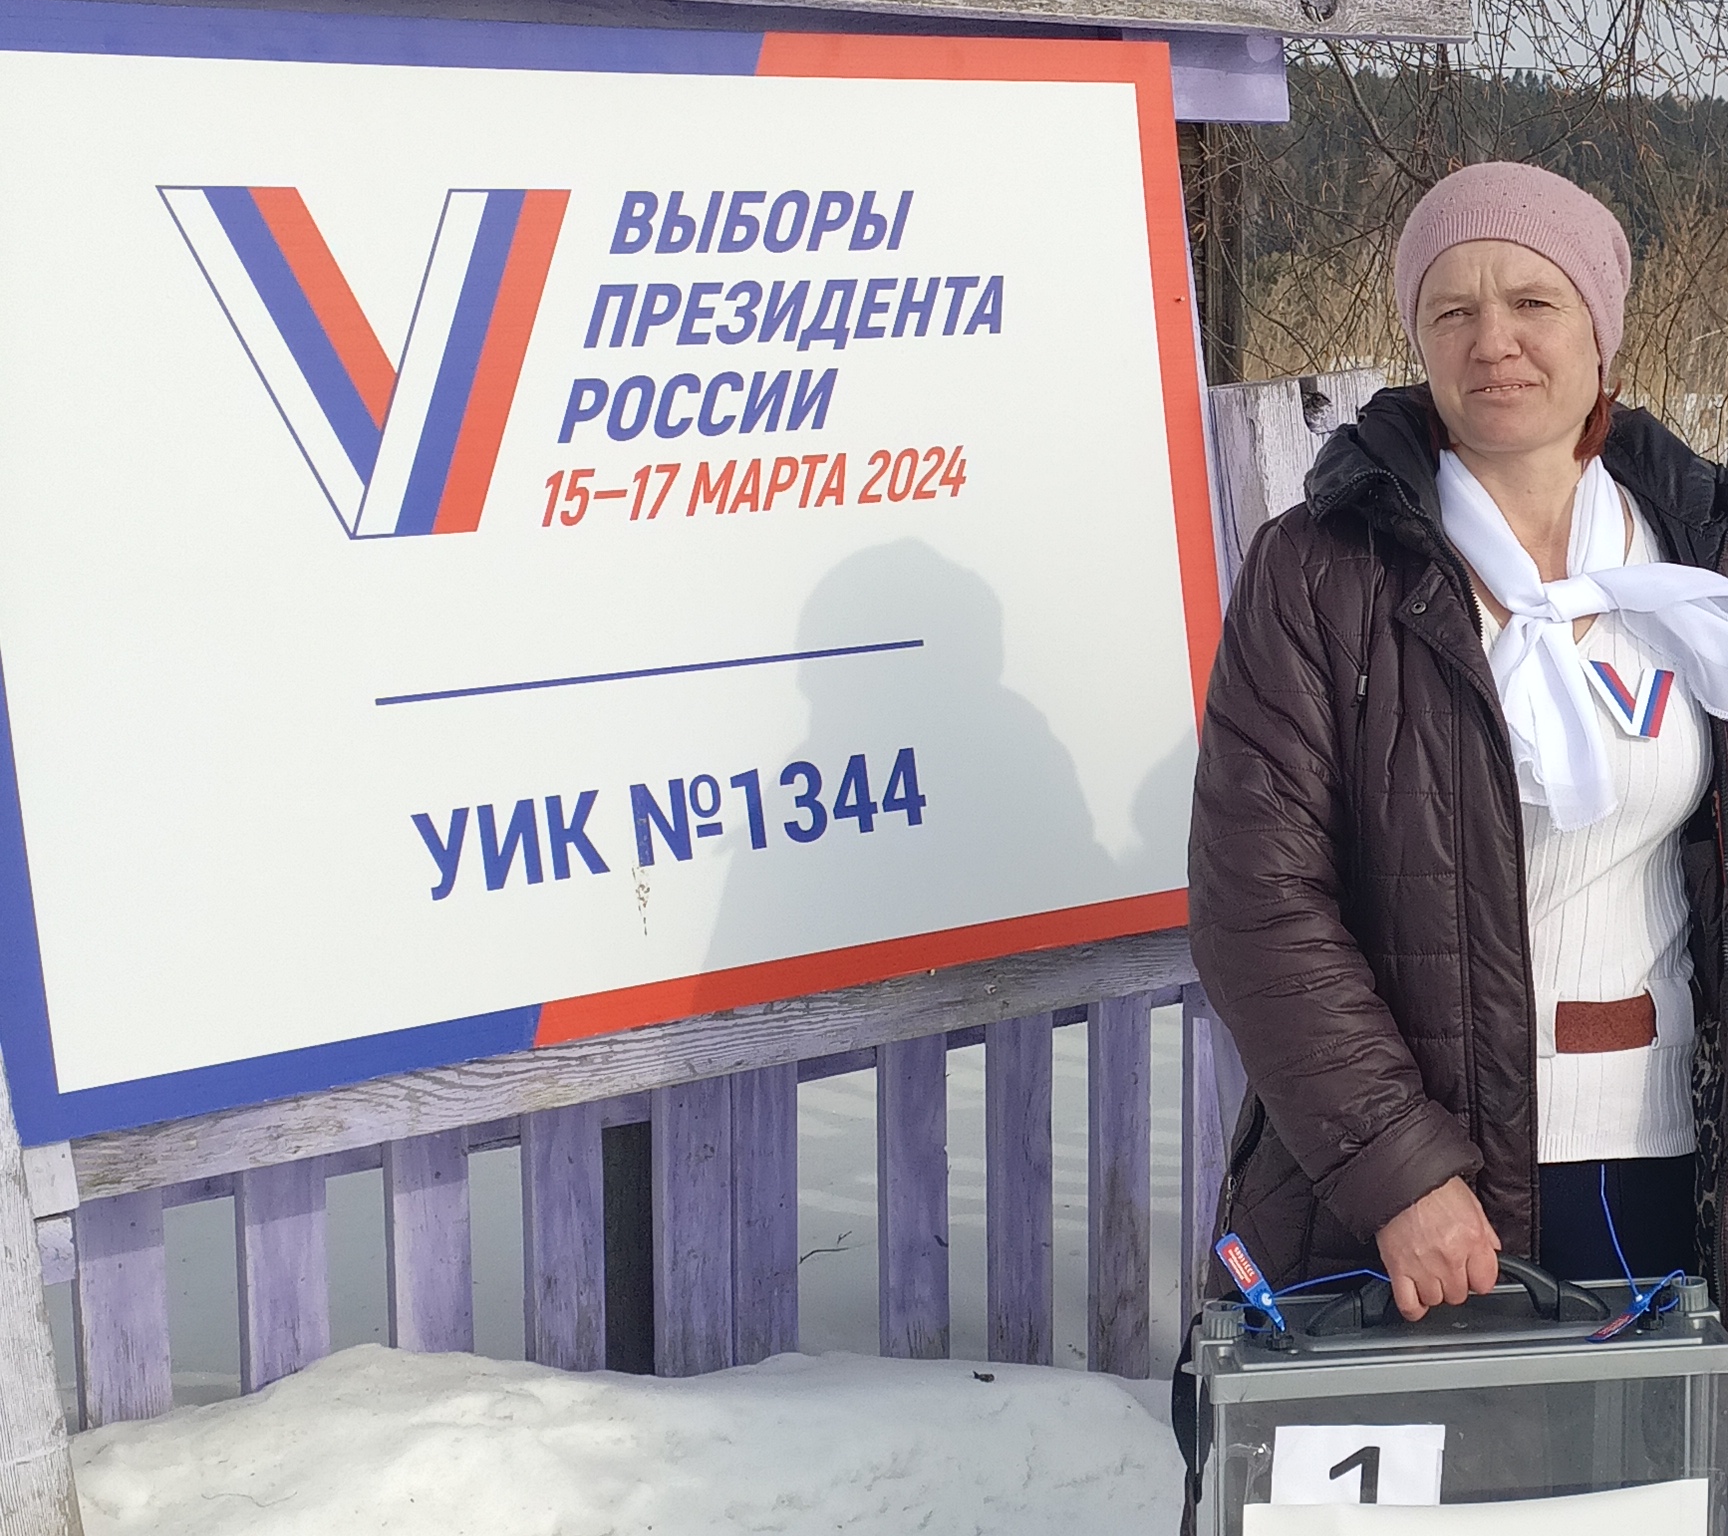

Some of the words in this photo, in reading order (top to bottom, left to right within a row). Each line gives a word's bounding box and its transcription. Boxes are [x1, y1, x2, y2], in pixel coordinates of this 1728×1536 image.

[609, 190, 913, 255] ВЫБОРЫ
[583, 275, 1003, 351] ПРЕЗИДЕНТА
[557, 368, 837, 444] РОССИИ
[686, 452, 847, 517] МАРТА
[857, 445, 967, 505] 2024
[410, 790, 609, 901] УИК
[629, 747, 927, 867] №1344
